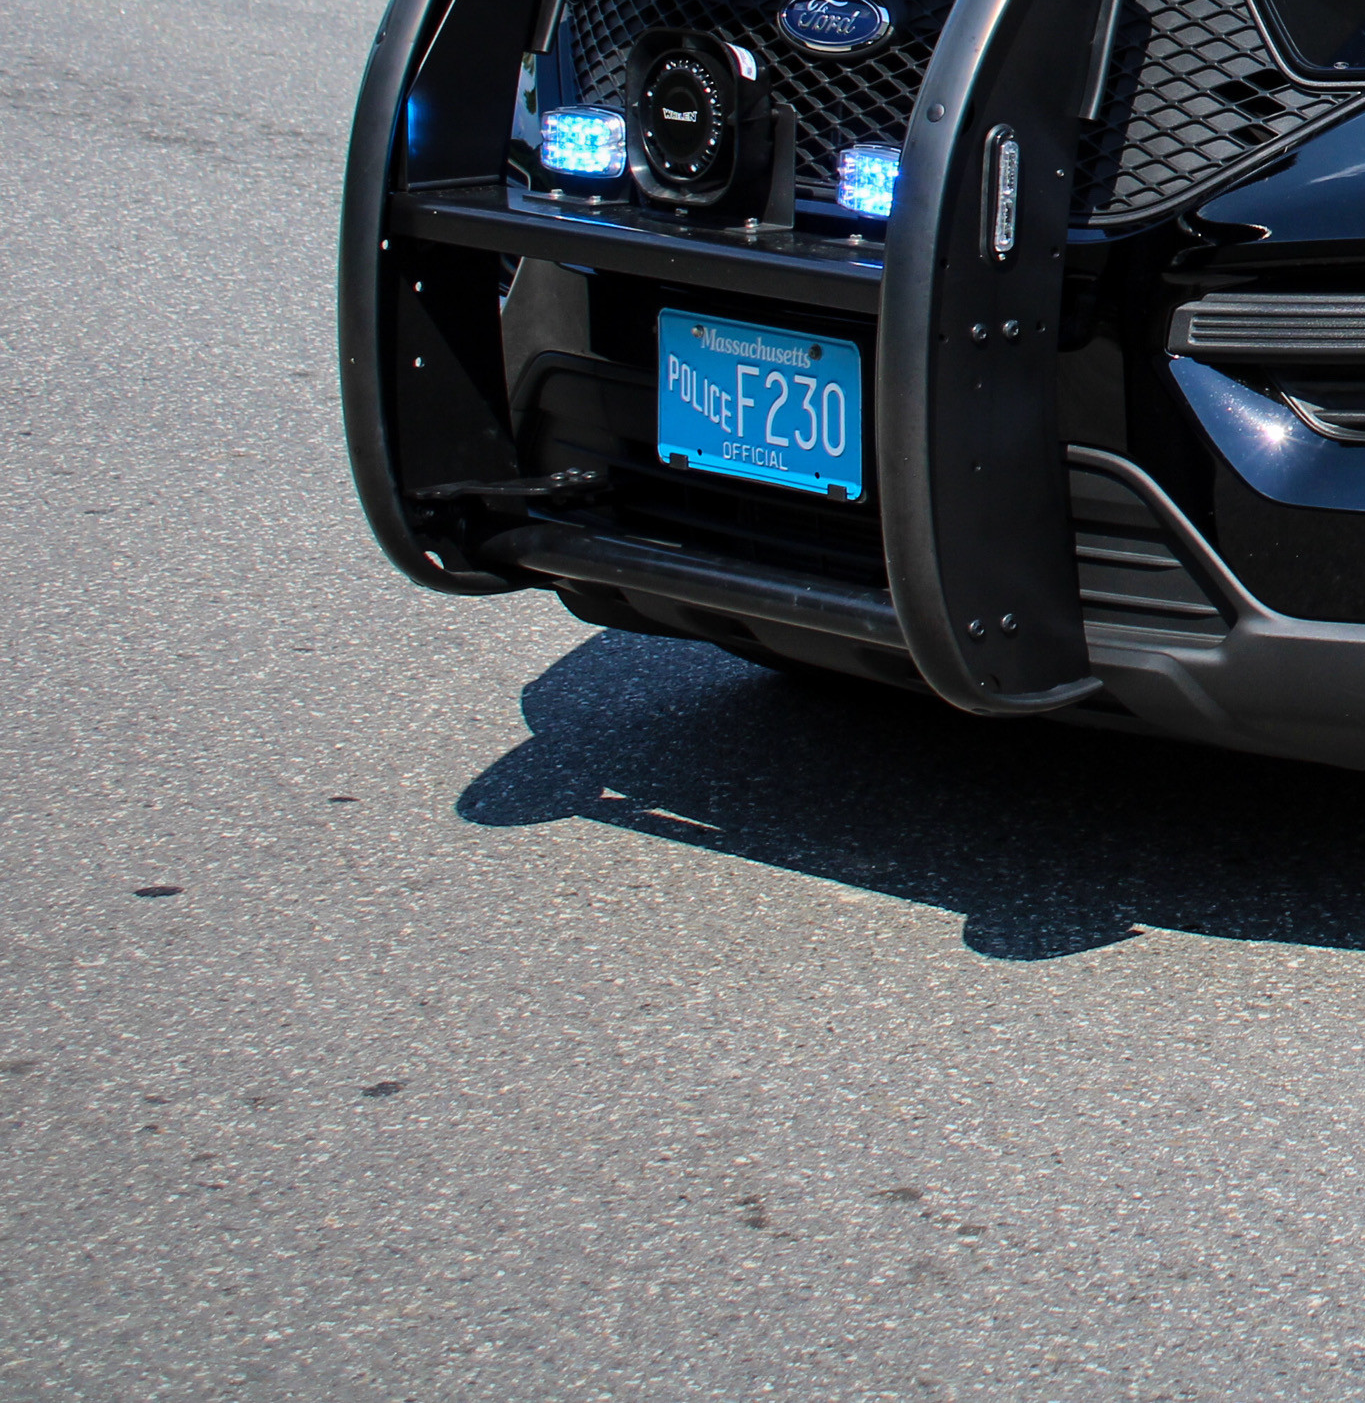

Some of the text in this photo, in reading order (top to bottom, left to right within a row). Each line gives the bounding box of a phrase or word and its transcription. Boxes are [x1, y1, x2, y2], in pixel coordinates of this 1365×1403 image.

[700, 326, 813, 370] Massachusetts
[668, 353, 847, 458] POLICE F230
[722, 441, 789, 472] OFFICIAL
